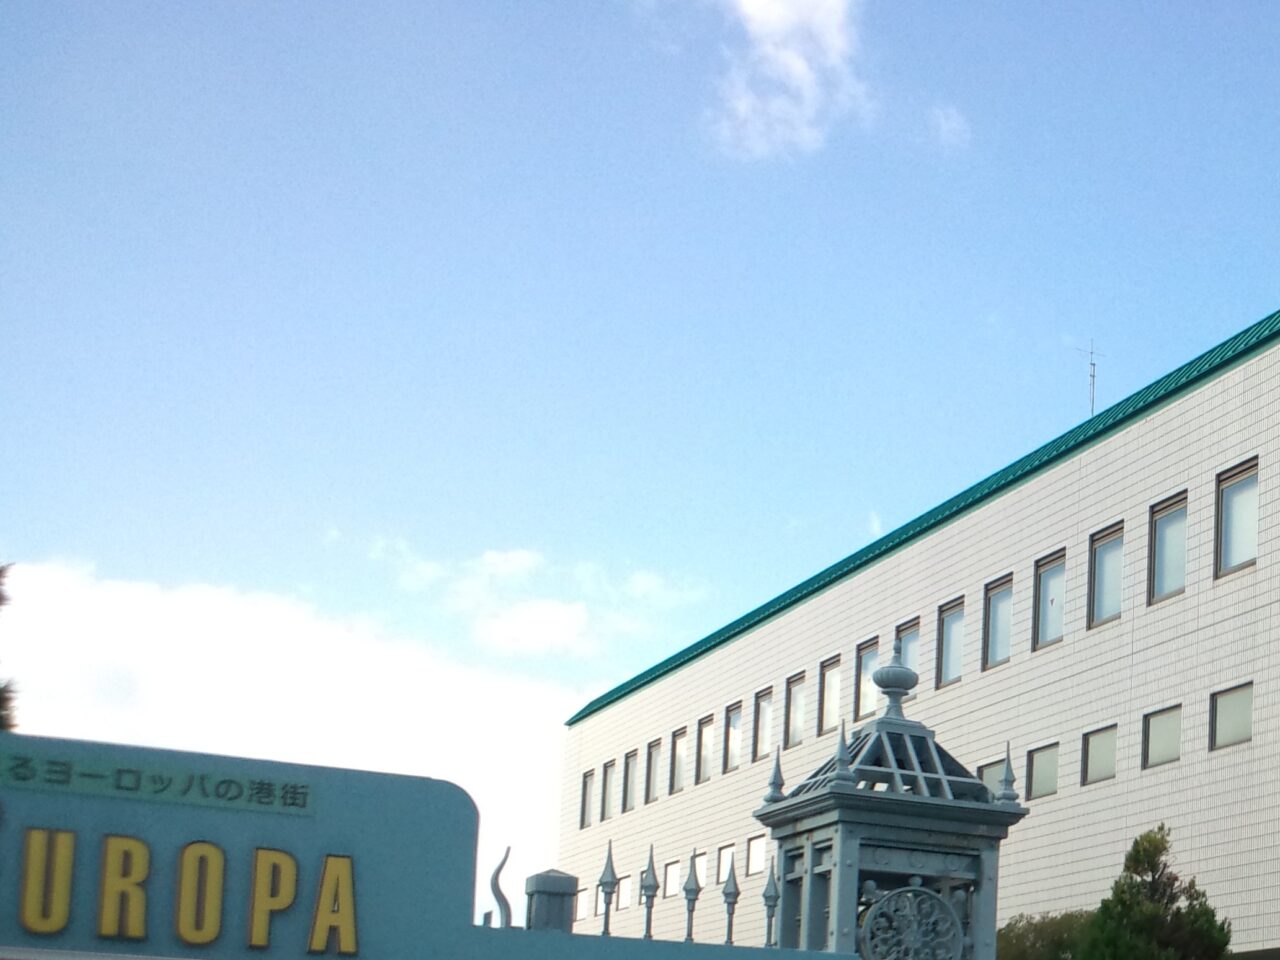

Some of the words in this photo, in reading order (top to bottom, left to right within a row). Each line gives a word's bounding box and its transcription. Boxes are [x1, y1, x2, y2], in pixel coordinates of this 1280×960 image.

[8, 756, 310, 809] るヨーロッパの港街
[19, 827, 359, 955] UROPA
